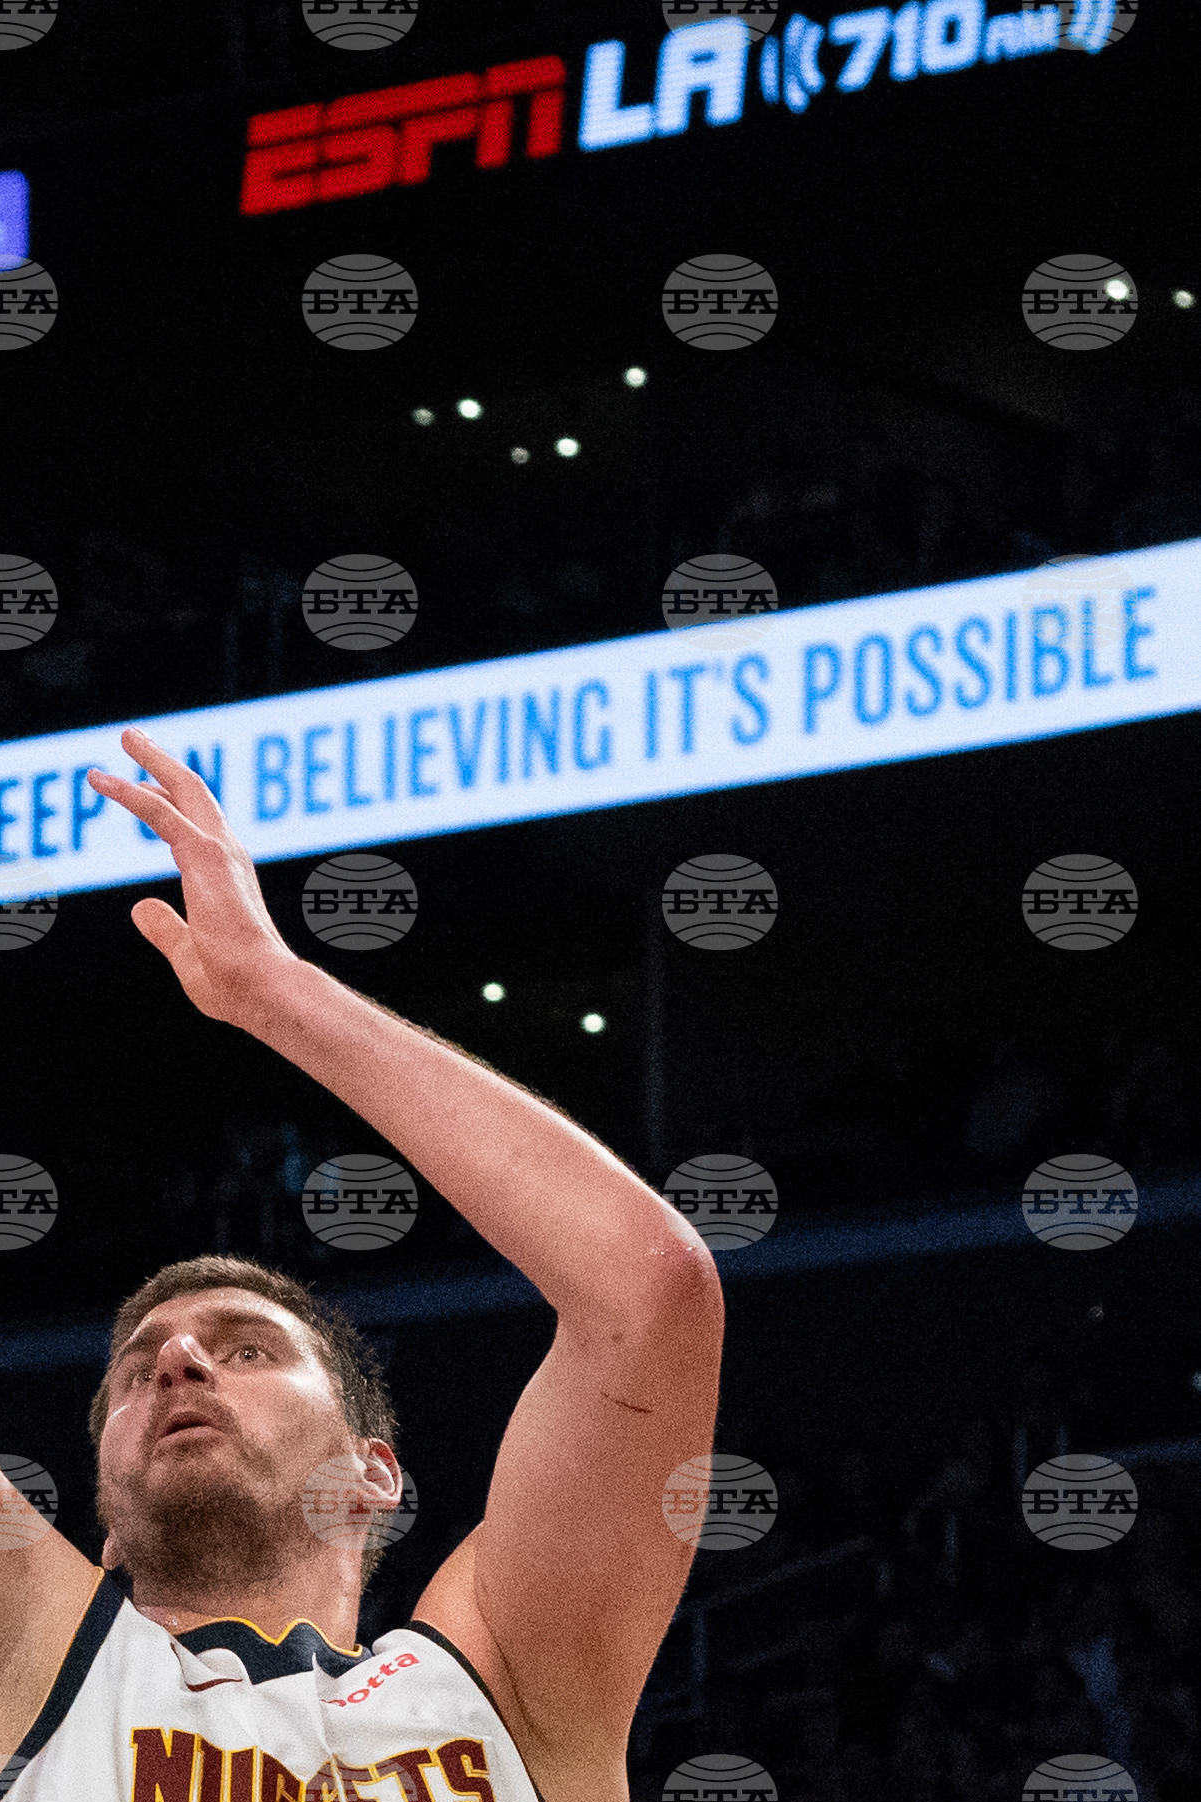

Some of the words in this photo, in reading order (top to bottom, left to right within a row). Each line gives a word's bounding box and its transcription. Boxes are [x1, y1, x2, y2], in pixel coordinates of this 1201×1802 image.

[240, 54, 567, 216] ESPN
[578, 15, 751, 153] LA
[252, 677, 613, 824] BELIEVING
[643, 652, 772, 761] IT'S
[802, 584, 1158, 736] POSSIBLE
